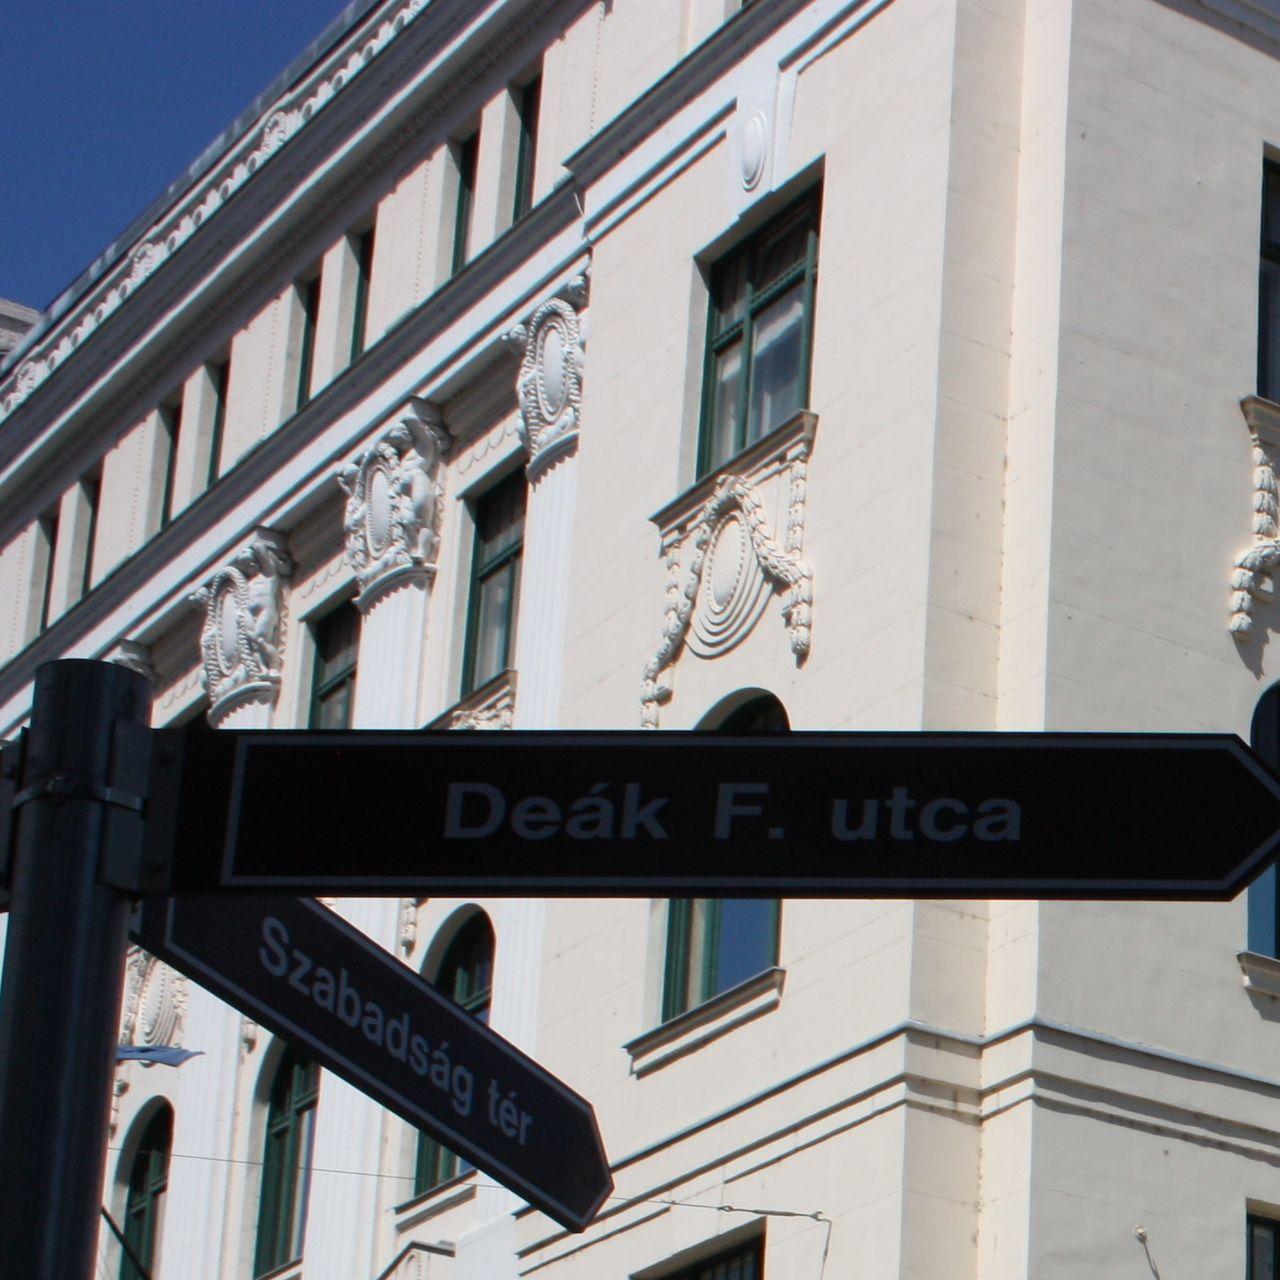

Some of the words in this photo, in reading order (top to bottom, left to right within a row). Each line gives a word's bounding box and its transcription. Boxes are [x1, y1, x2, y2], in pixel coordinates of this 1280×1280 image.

[444, 781, 670, 840] Deák
[714, 782, 784, 840] F.
[830, 786, 1022, 841] utca
[258, 915, 474, 1117] Szabadság
[488, 1078, 534, 1146] tér
